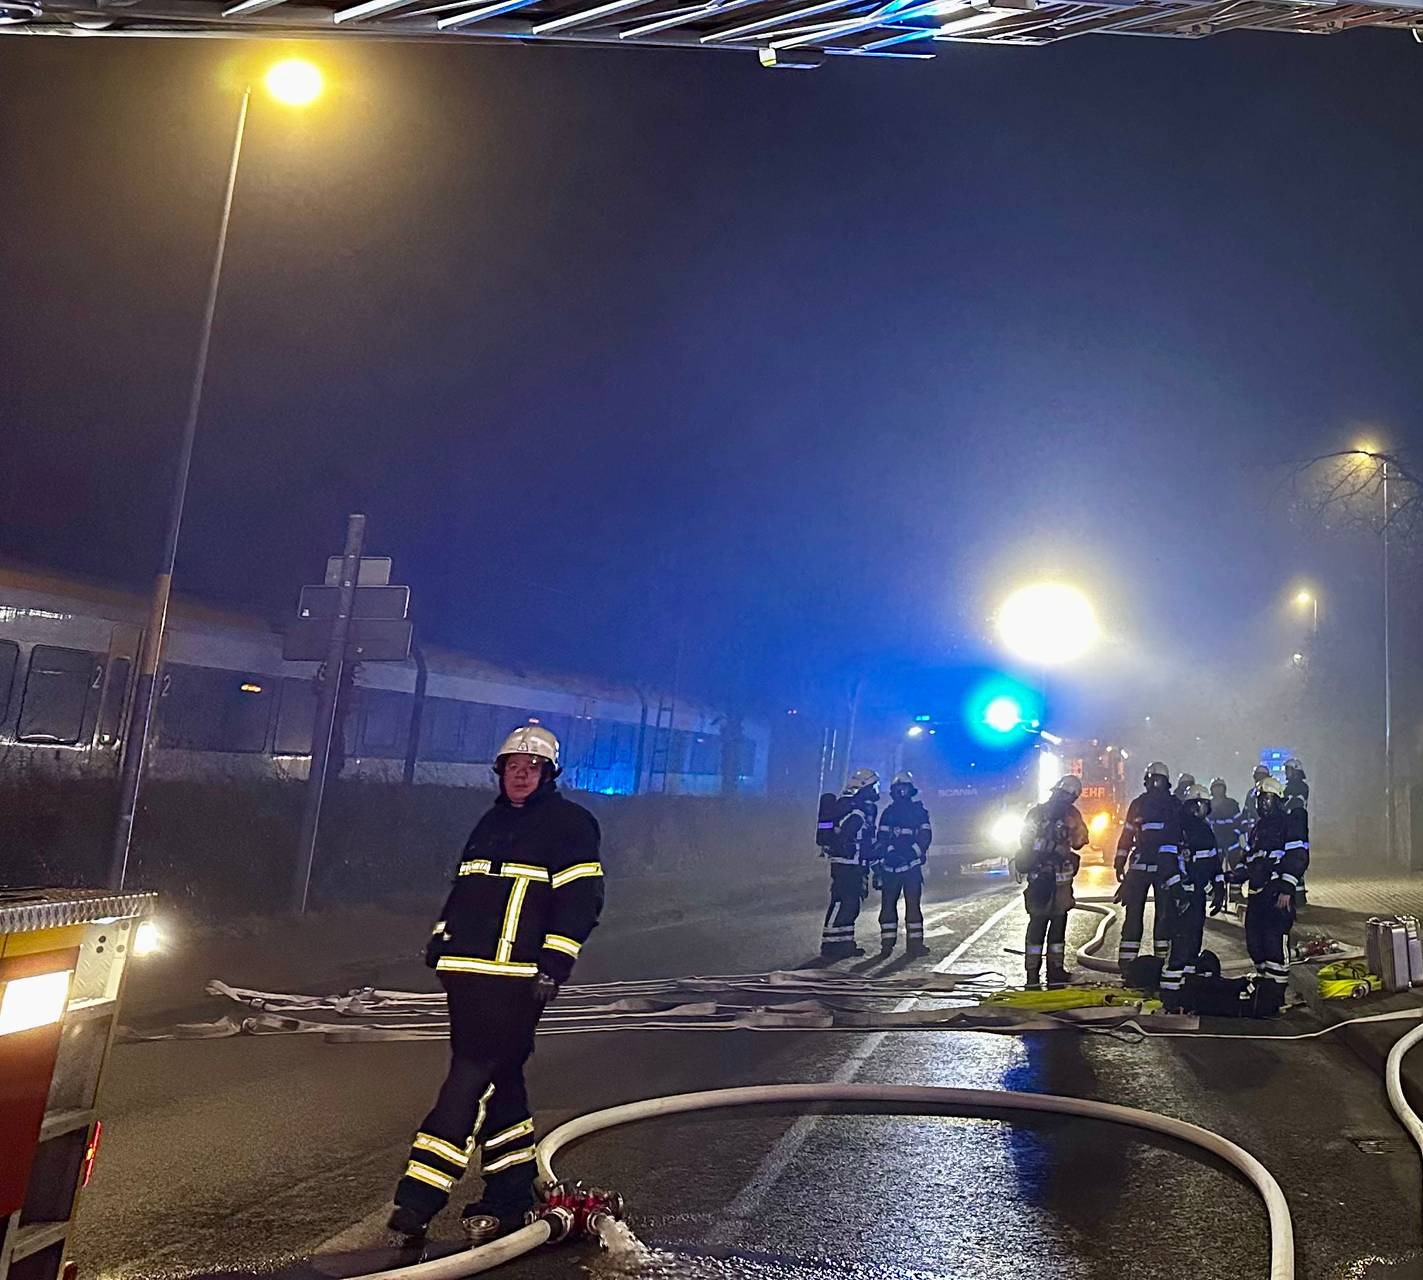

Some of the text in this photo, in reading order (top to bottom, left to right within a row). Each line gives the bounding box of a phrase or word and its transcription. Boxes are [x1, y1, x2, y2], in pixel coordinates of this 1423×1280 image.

[92, 665, 103, 689] 2
[161, 674, 171, 697] 2
[1081, 786, 1106, 799] EHR
